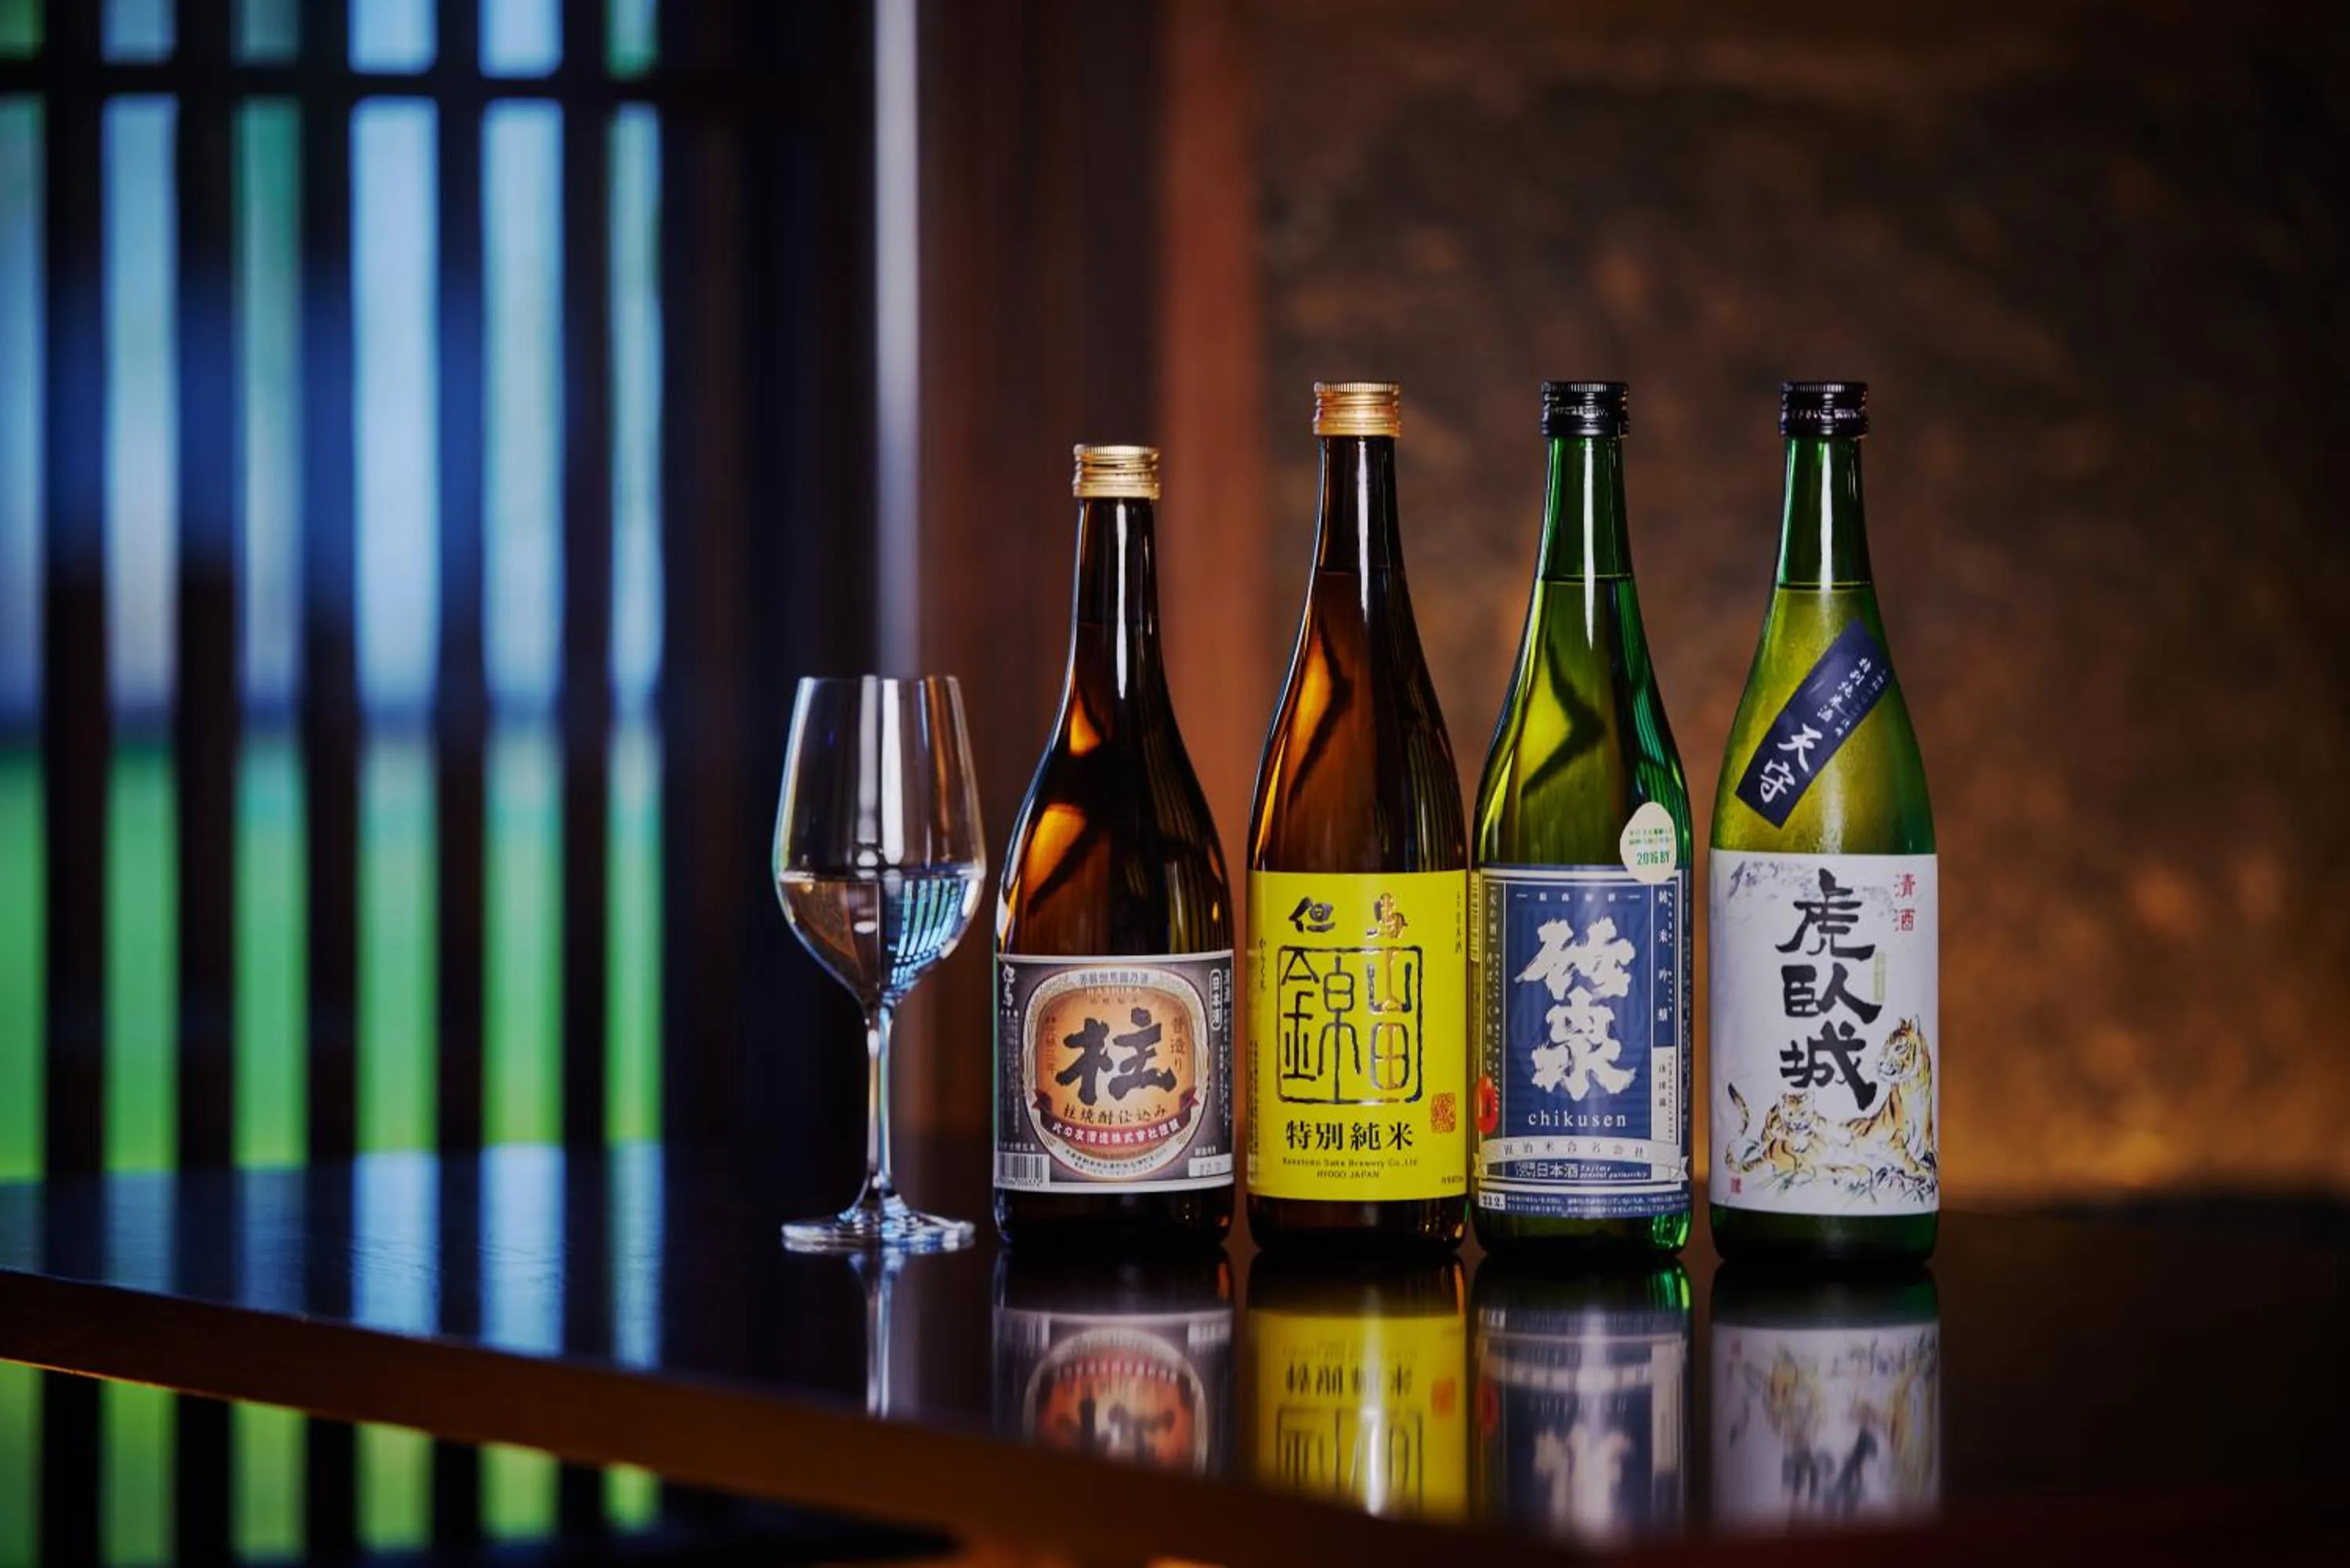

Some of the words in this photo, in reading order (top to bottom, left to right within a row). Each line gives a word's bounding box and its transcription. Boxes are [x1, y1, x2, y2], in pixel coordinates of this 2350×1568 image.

[1760, 722, 1823, 803] 天守
[1893, 873, 1916, 932] 清酒
[1514, 916, 1636, 1101] 竹泉
[1775, 867, 1882, 1111] 虎臥城
[1055, 1006, 1177, 1106] 柱
[1285, 1119, 1414, 1151] 特別純米
[1528, 1109, 1627, 1128] chikusen
[1350, 1170, 1379, 1179] JAPAN
